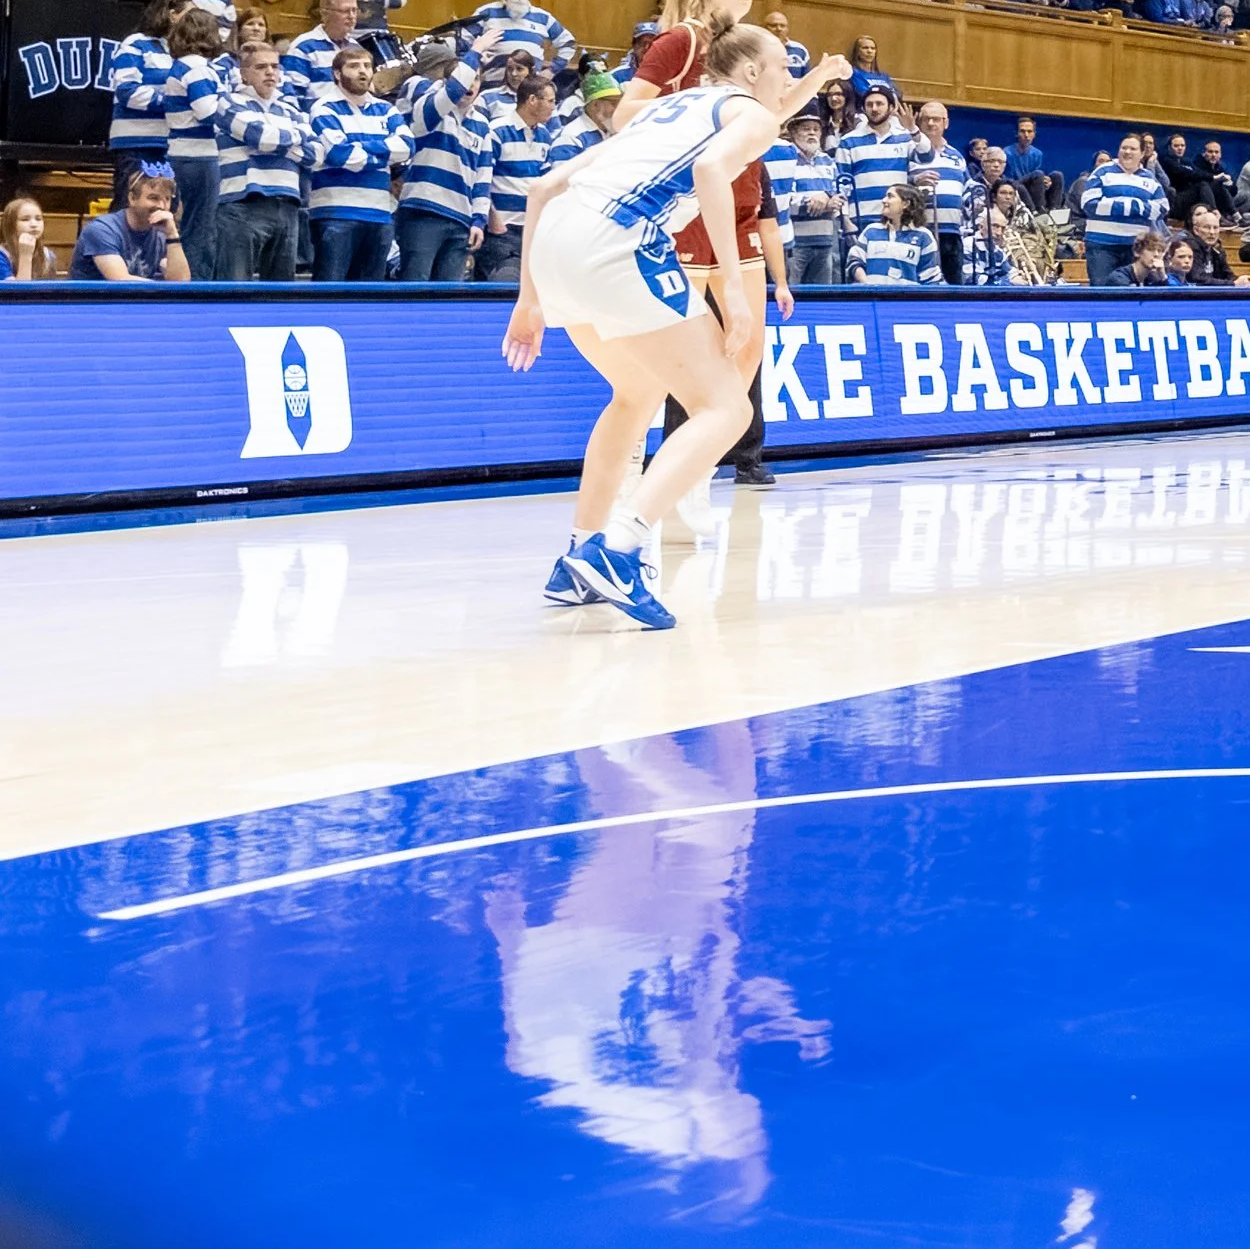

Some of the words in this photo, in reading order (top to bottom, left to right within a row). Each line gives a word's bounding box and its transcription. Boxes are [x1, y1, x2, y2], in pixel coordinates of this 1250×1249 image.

[654, 273, 686, 298] D
[763, 324, 874, 423] KE
[196, 486, 249, 497] DAKTRONICS
